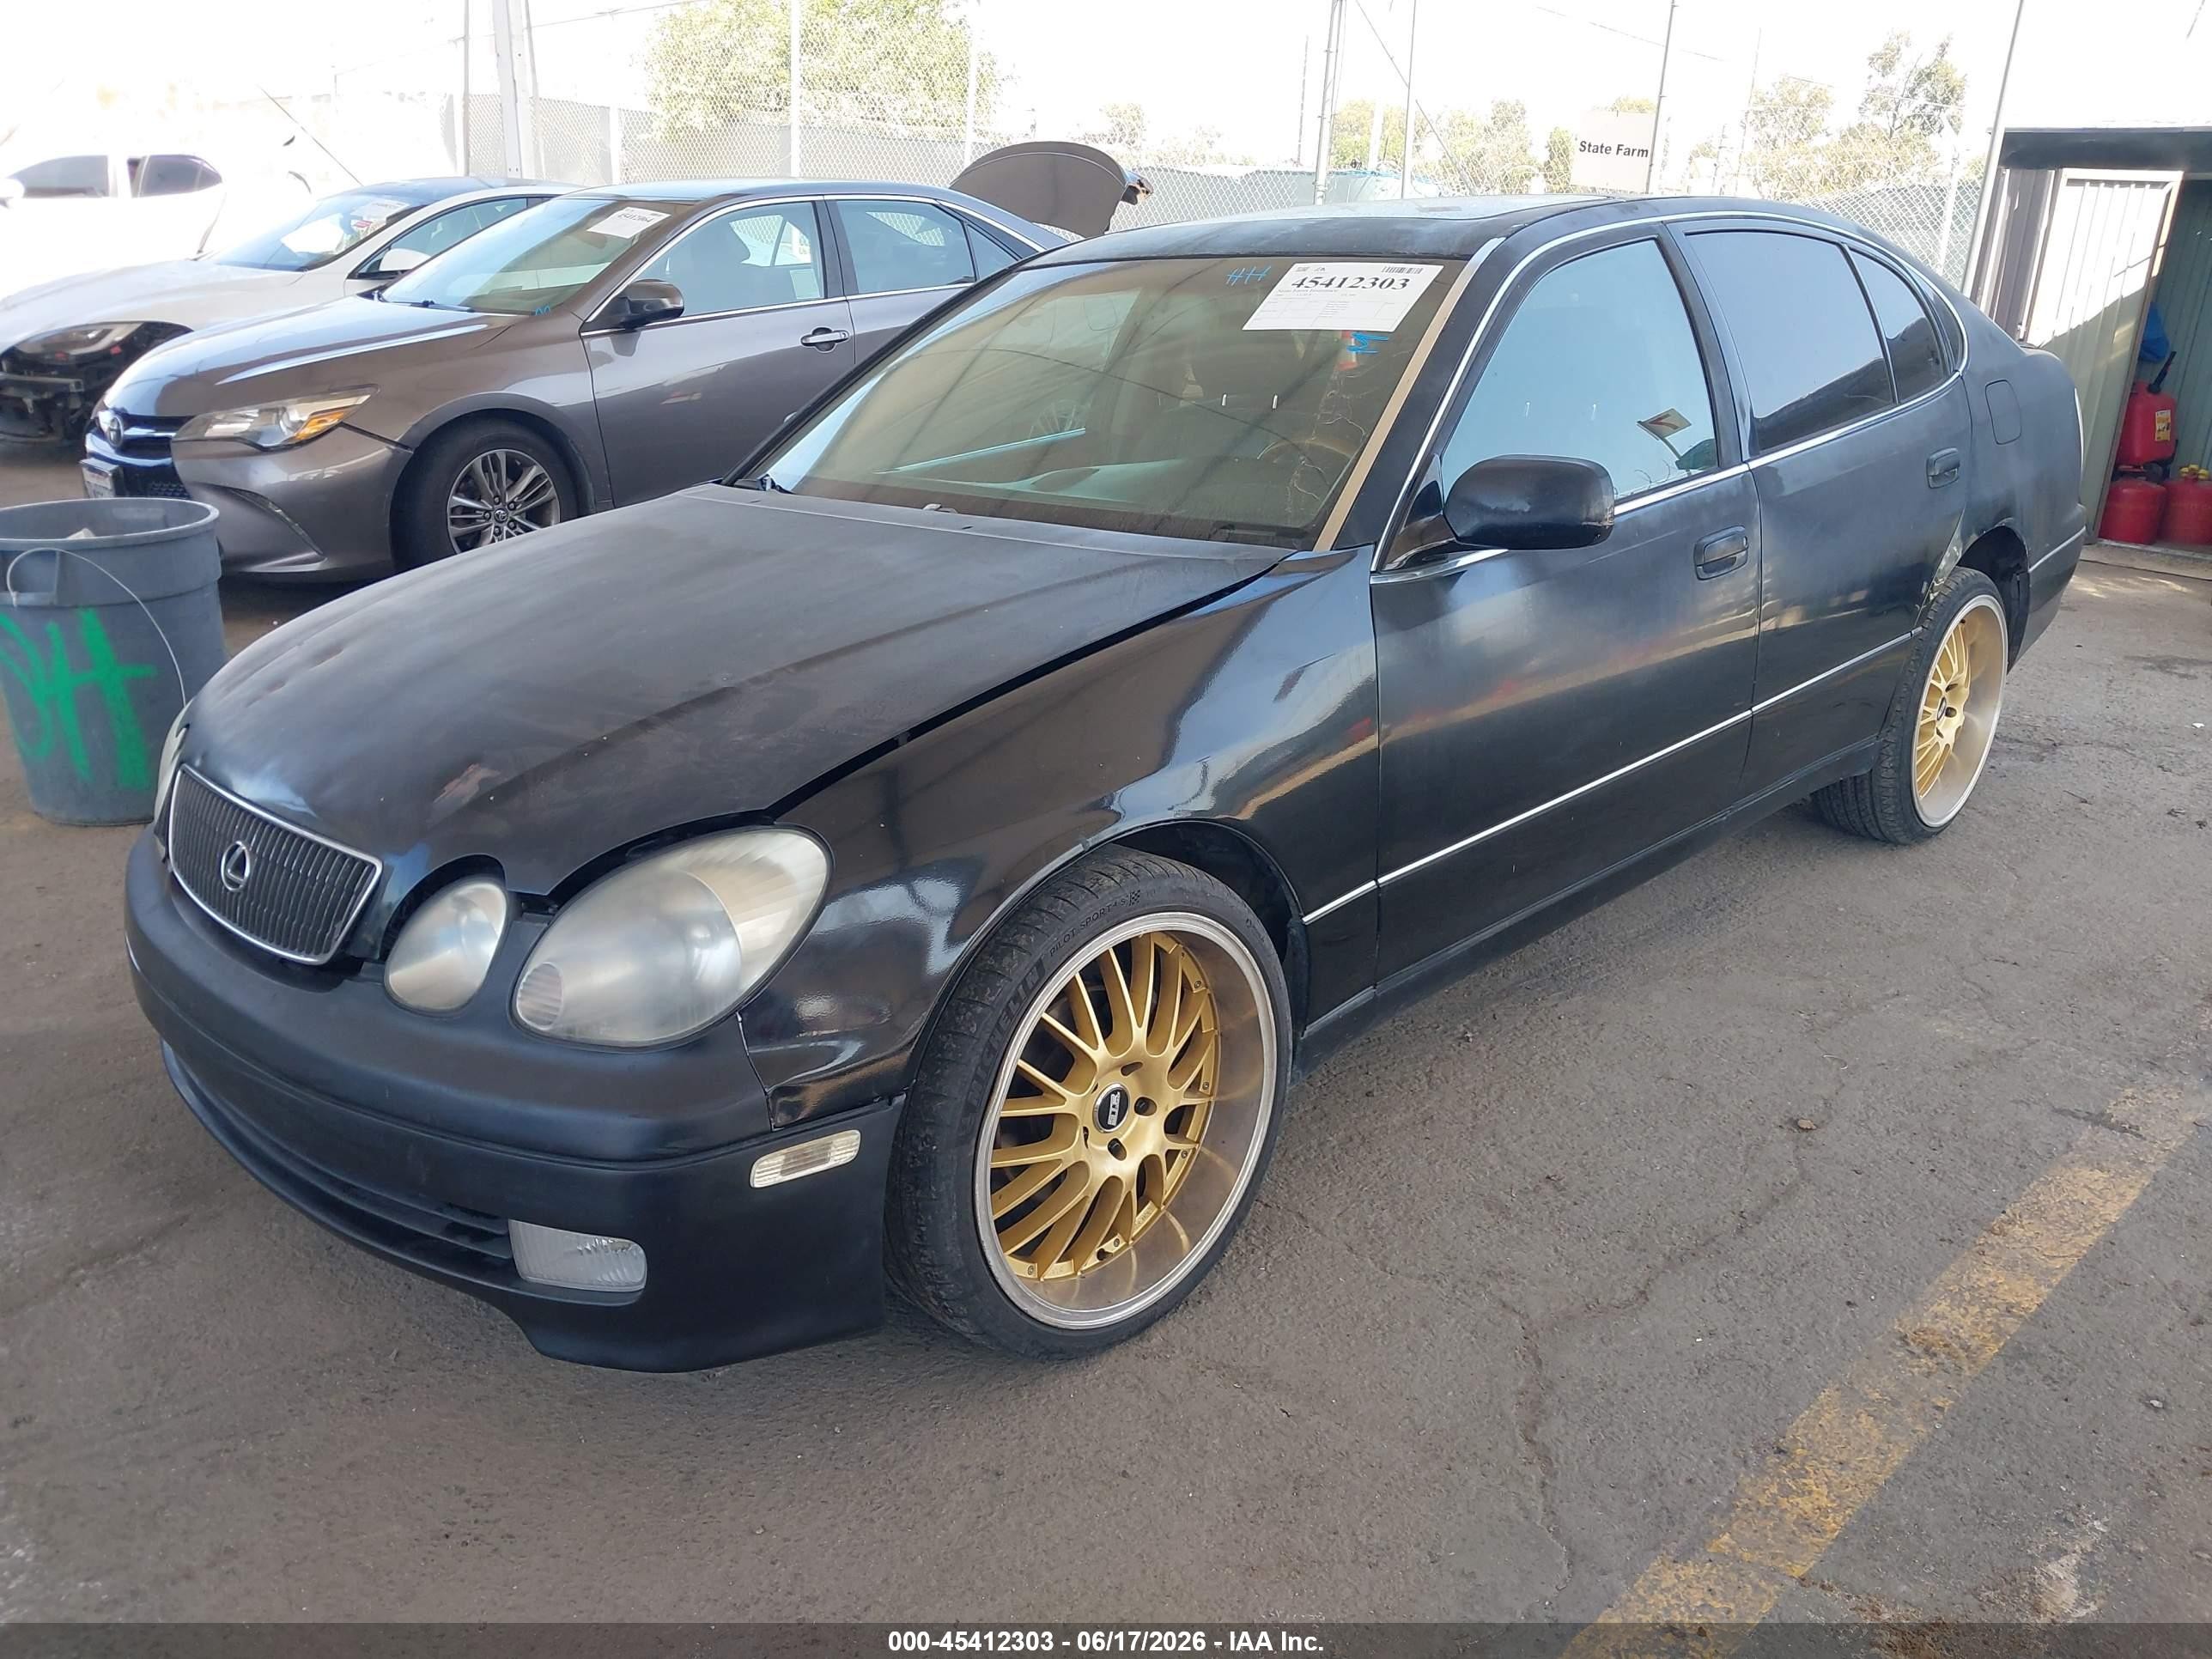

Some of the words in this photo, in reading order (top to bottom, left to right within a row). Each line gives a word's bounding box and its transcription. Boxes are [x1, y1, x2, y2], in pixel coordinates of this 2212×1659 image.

[1579, 140, 1612, 155] State
[1616, 144, 1649, 157] Farm
[1291, 276, 1410, 290] 45412303
[965, 963, 1041, 1107] MICHELIN
[1049, 930, 1075, 956] PILOT
[1081, 905, 1113, 928] SPORT
